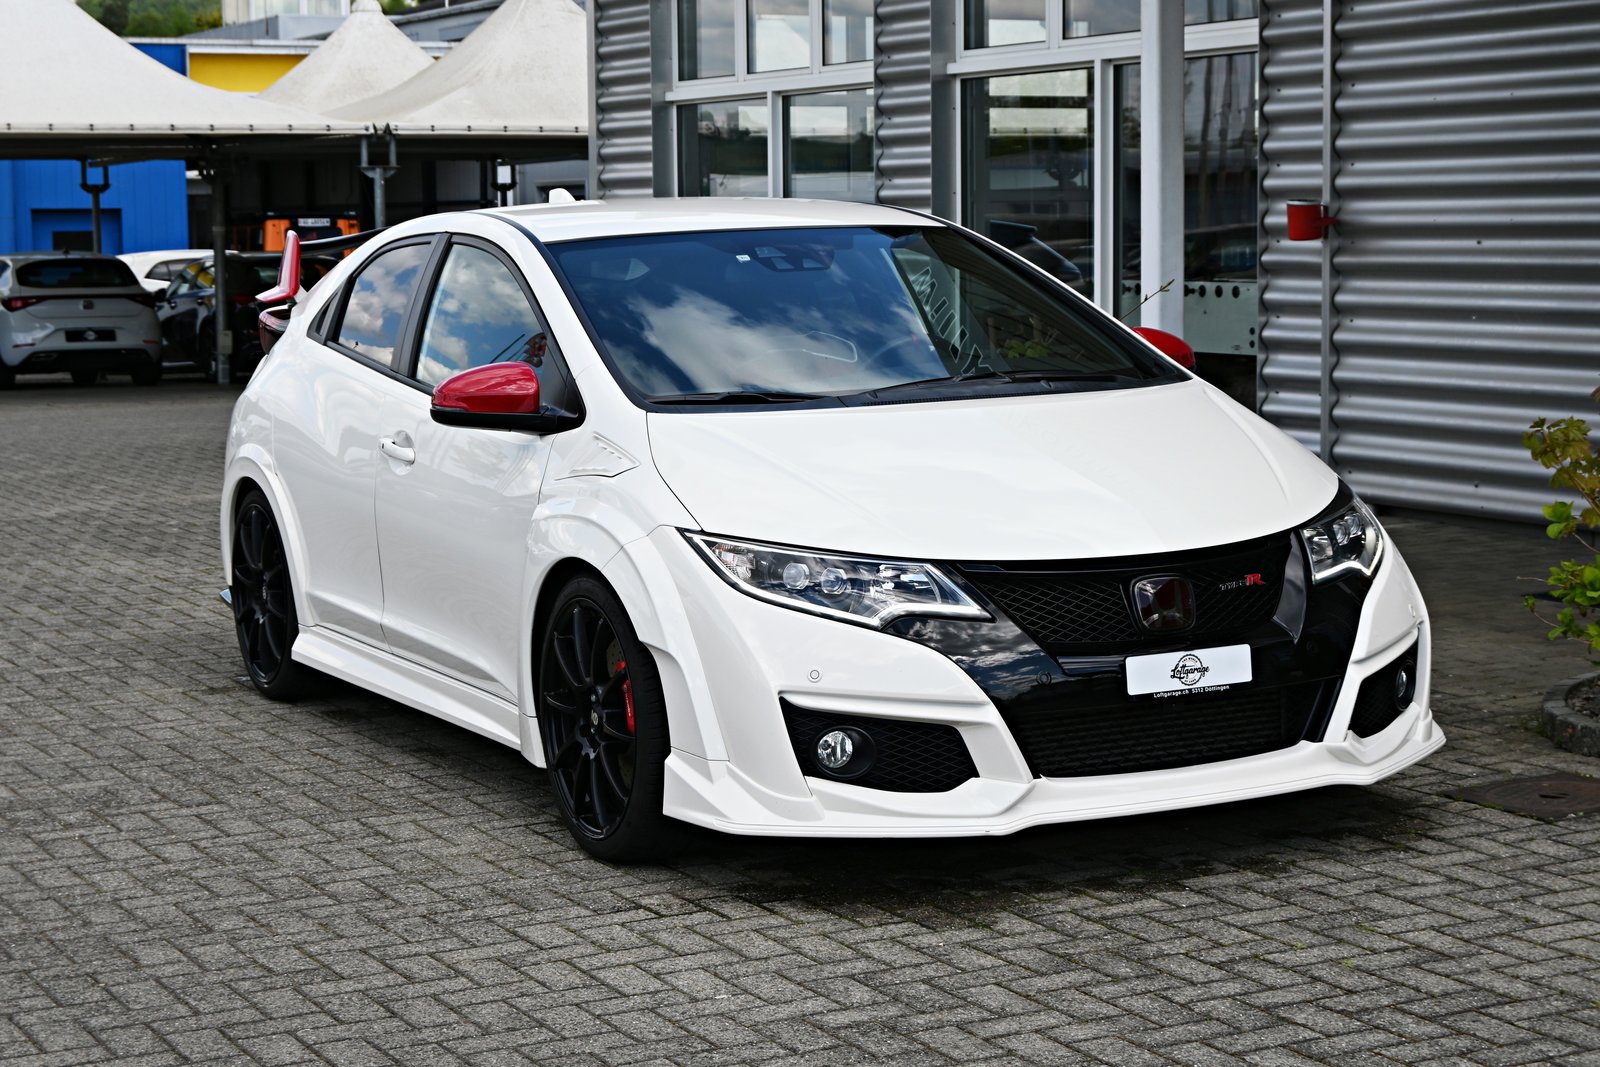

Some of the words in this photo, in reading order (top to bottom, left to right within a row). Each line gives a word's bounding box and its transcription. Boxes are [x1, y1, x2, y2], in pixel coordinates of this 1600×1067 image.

[1245, 573, 1265, 585] R
[1170, 663, 1210, 679] Loftgarage
[1153, 689, 1189, 698] Loftgarage.ch
